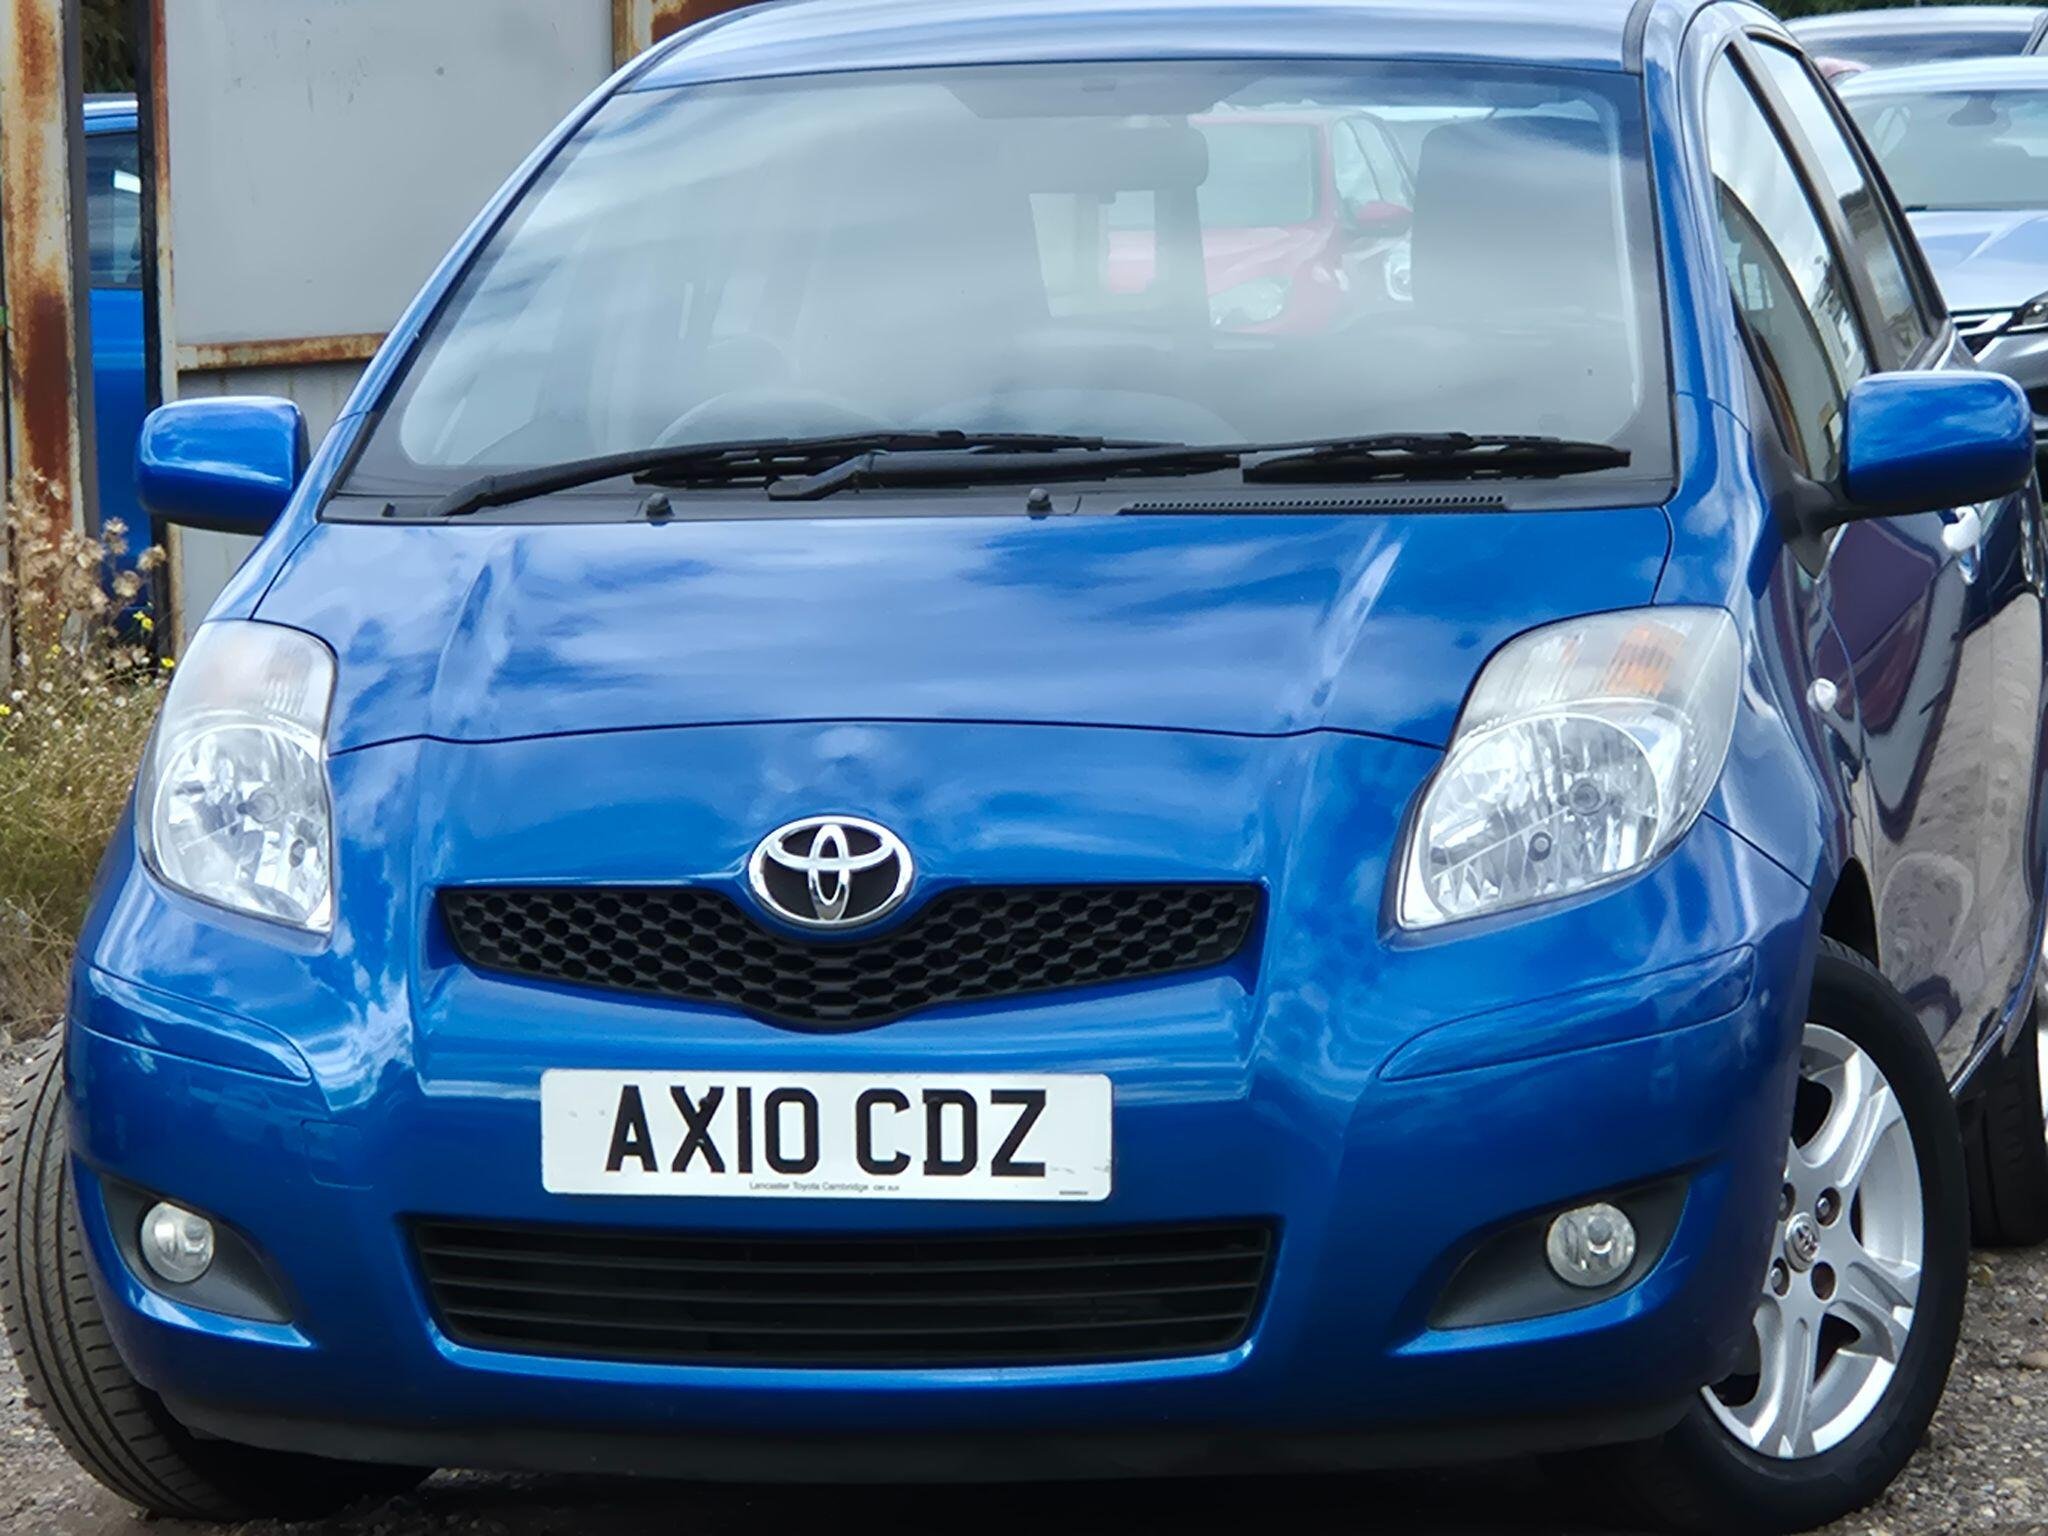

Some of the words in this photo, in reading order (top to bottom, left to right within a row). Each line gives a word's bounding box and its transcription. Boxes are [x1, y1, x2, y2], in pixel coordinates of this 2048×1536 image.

[855, 1088, 1046, 1177] CDZ
[749, 1181, 790, 1191] Lancaster
[793, 1182, 820, 1191] Toyota
[822, 1181, 869, 1193] Cambridge
